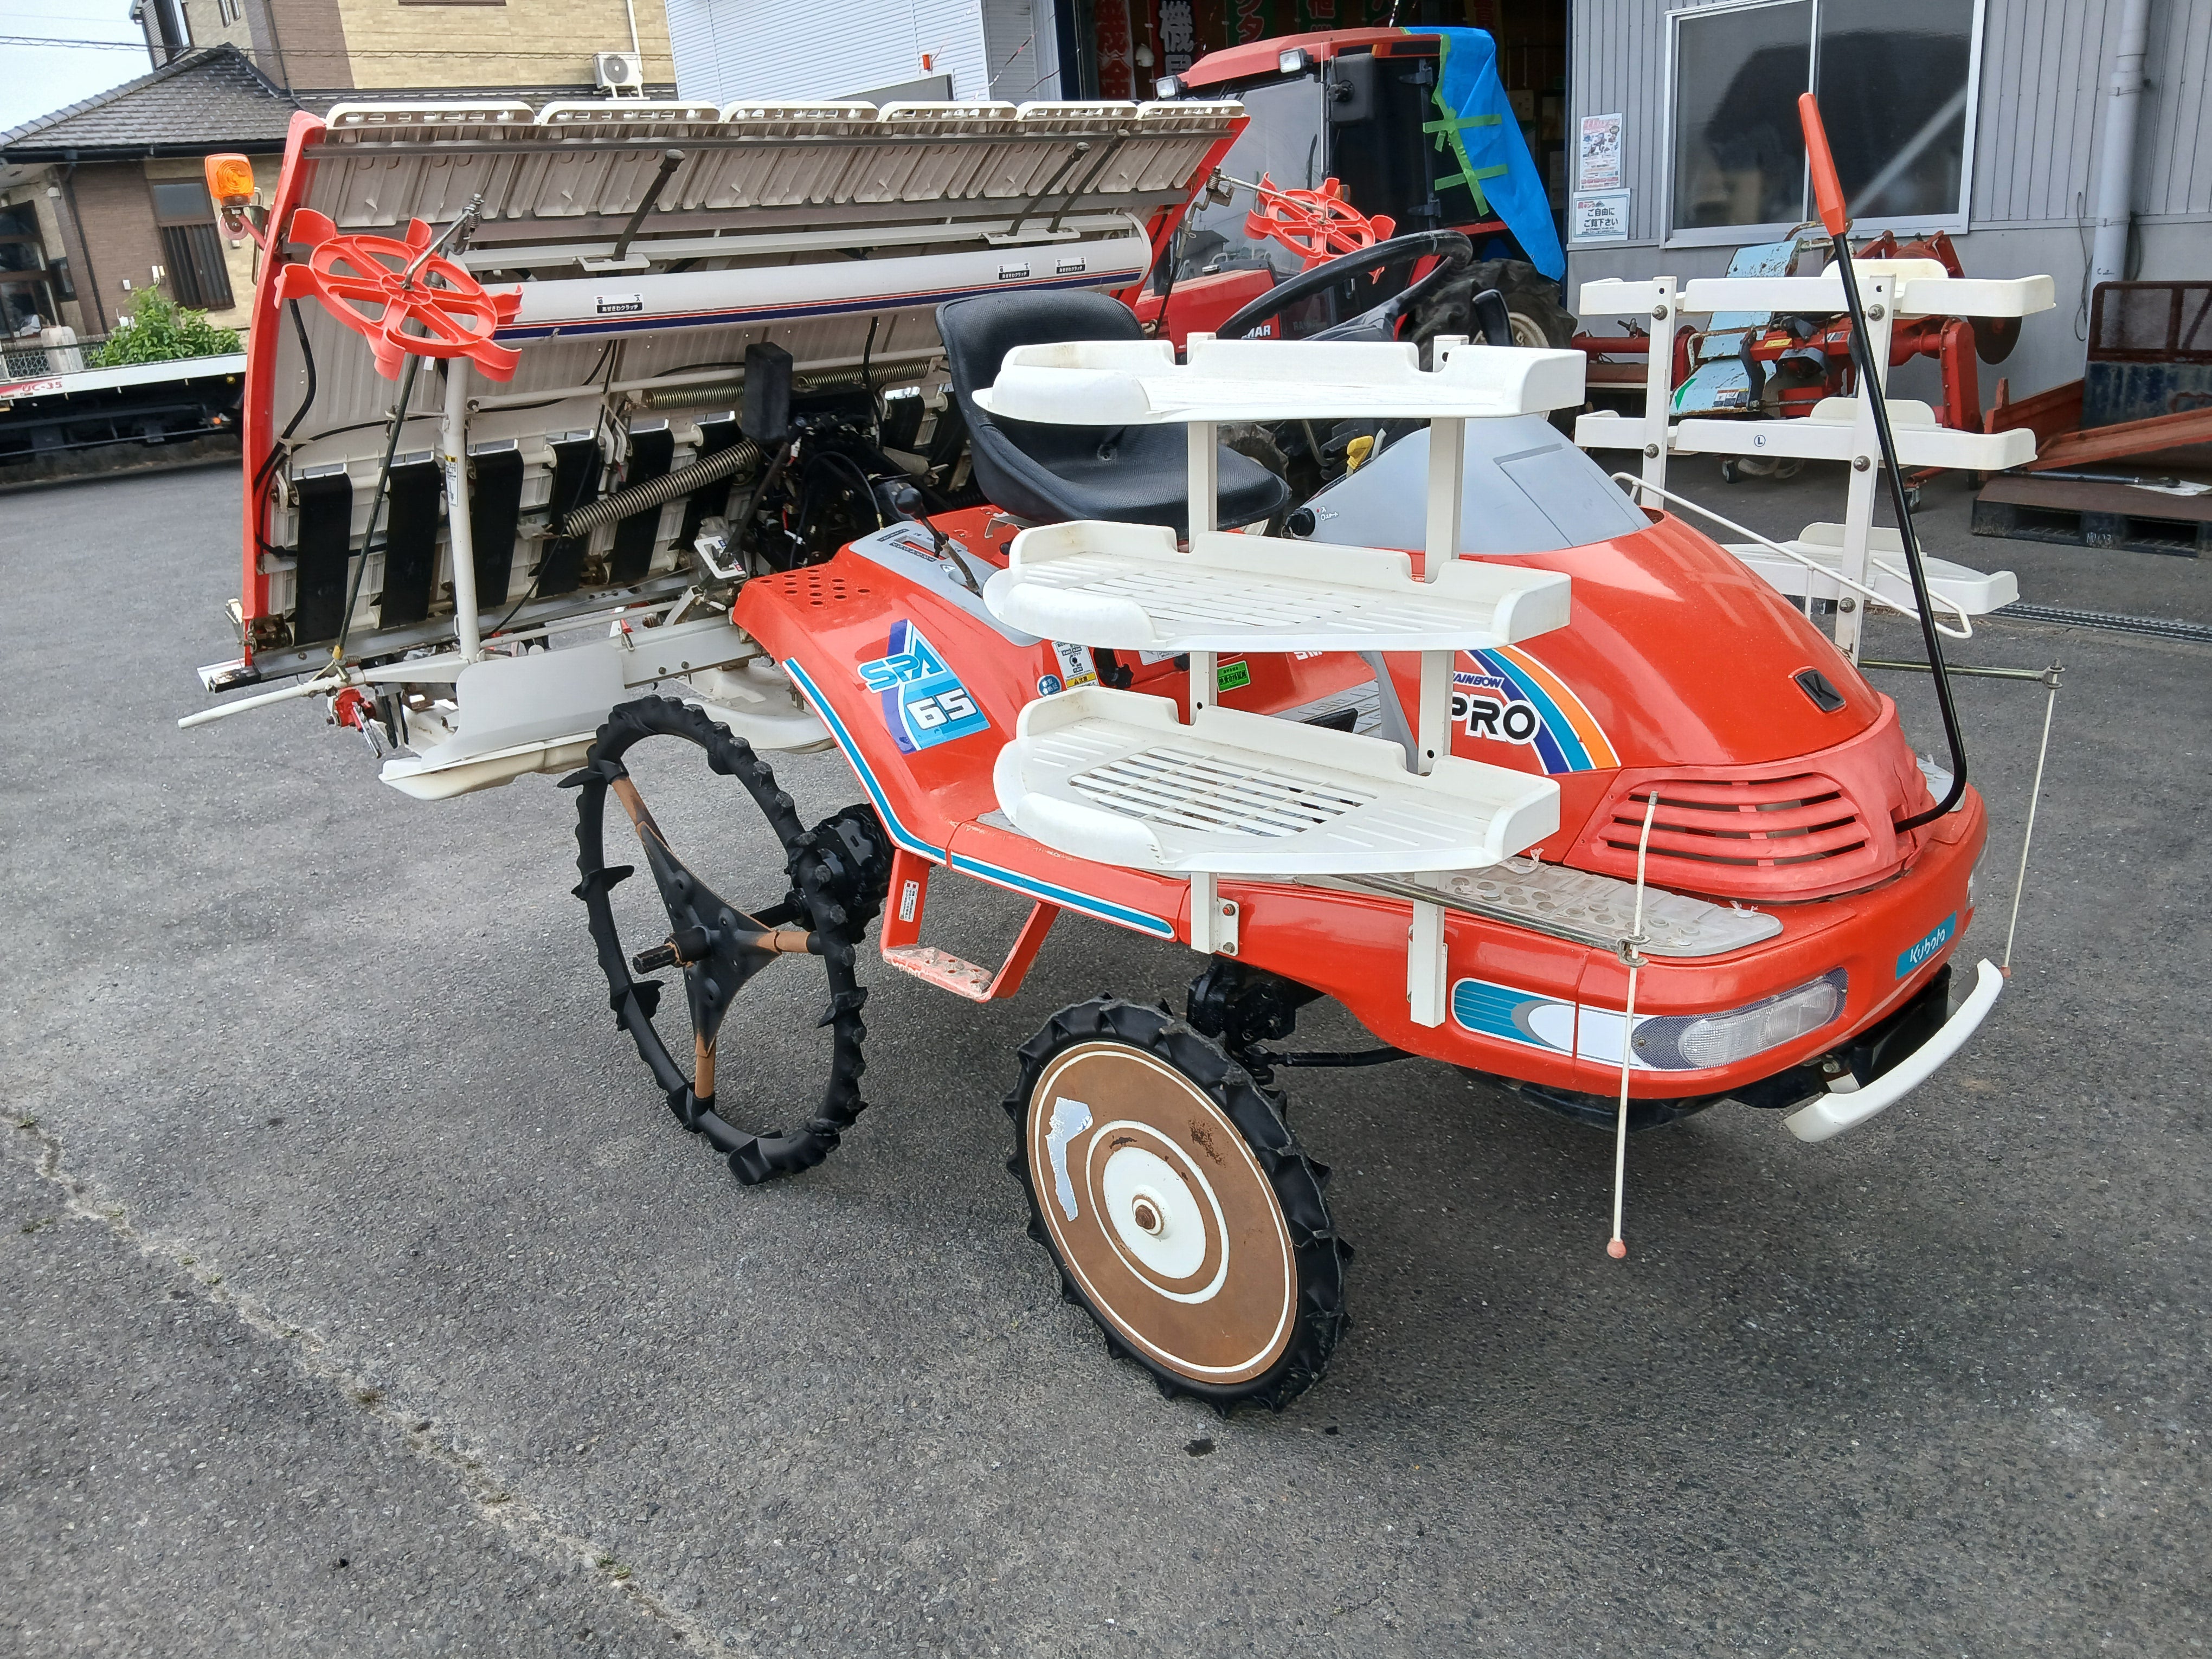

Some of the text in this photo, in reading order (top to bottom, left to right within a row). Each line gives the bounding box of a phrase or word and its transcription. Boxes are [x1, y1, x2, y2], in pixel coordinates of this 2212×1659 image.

[1584, 218, 1618, 227] ご覧下さい
[1587, 208, 1615, 216] ご自由に
[1242, 325, 1271, 339] MAR
[860, 638, 944, 691] SPA
[906, 687, 978, 730] 65
[1451, 696, 1536, 740] PRO
[1909, 928, 1945, 963] Kubota
